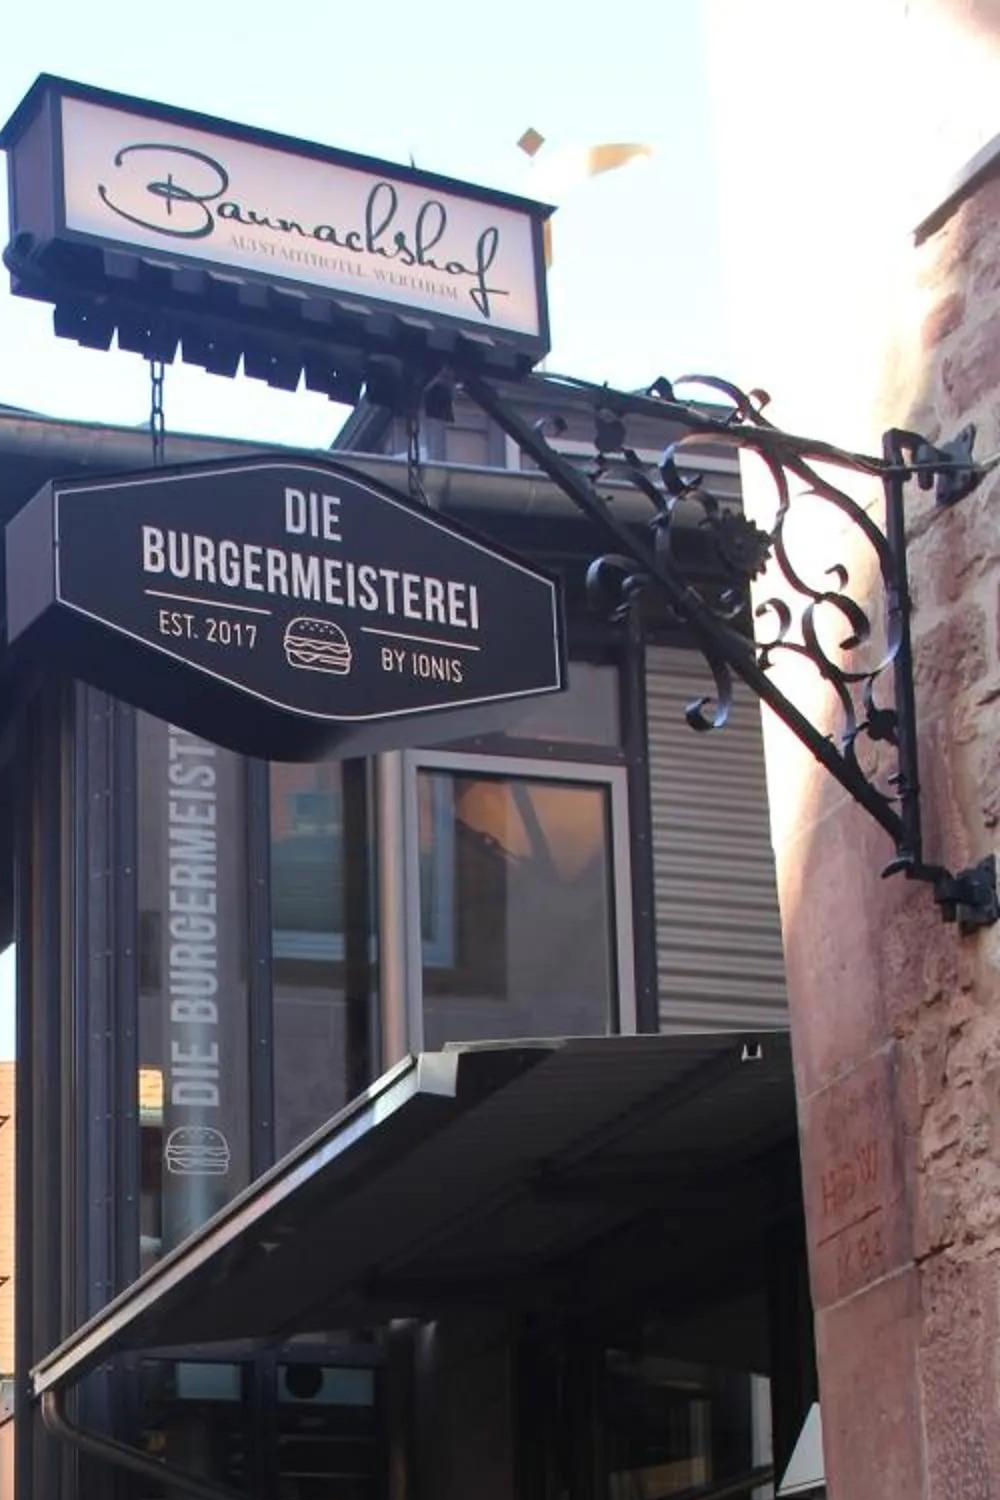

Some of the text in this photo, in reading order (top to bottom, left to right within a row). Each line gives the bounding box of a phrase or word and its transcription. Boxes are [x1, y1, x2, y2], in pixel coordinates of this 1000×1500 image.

[97, 143, 510, 319] Baunachshof
[283, 487, 343, 542] DIE
[141, 525, 480, 630] BURGERMEISTEREI
[158, 608, 257, 649] EST. 2017
[381, 647, 463, 684] BY IONIS
[168, 723, 219, 1107] DIE BURGERMEIST
